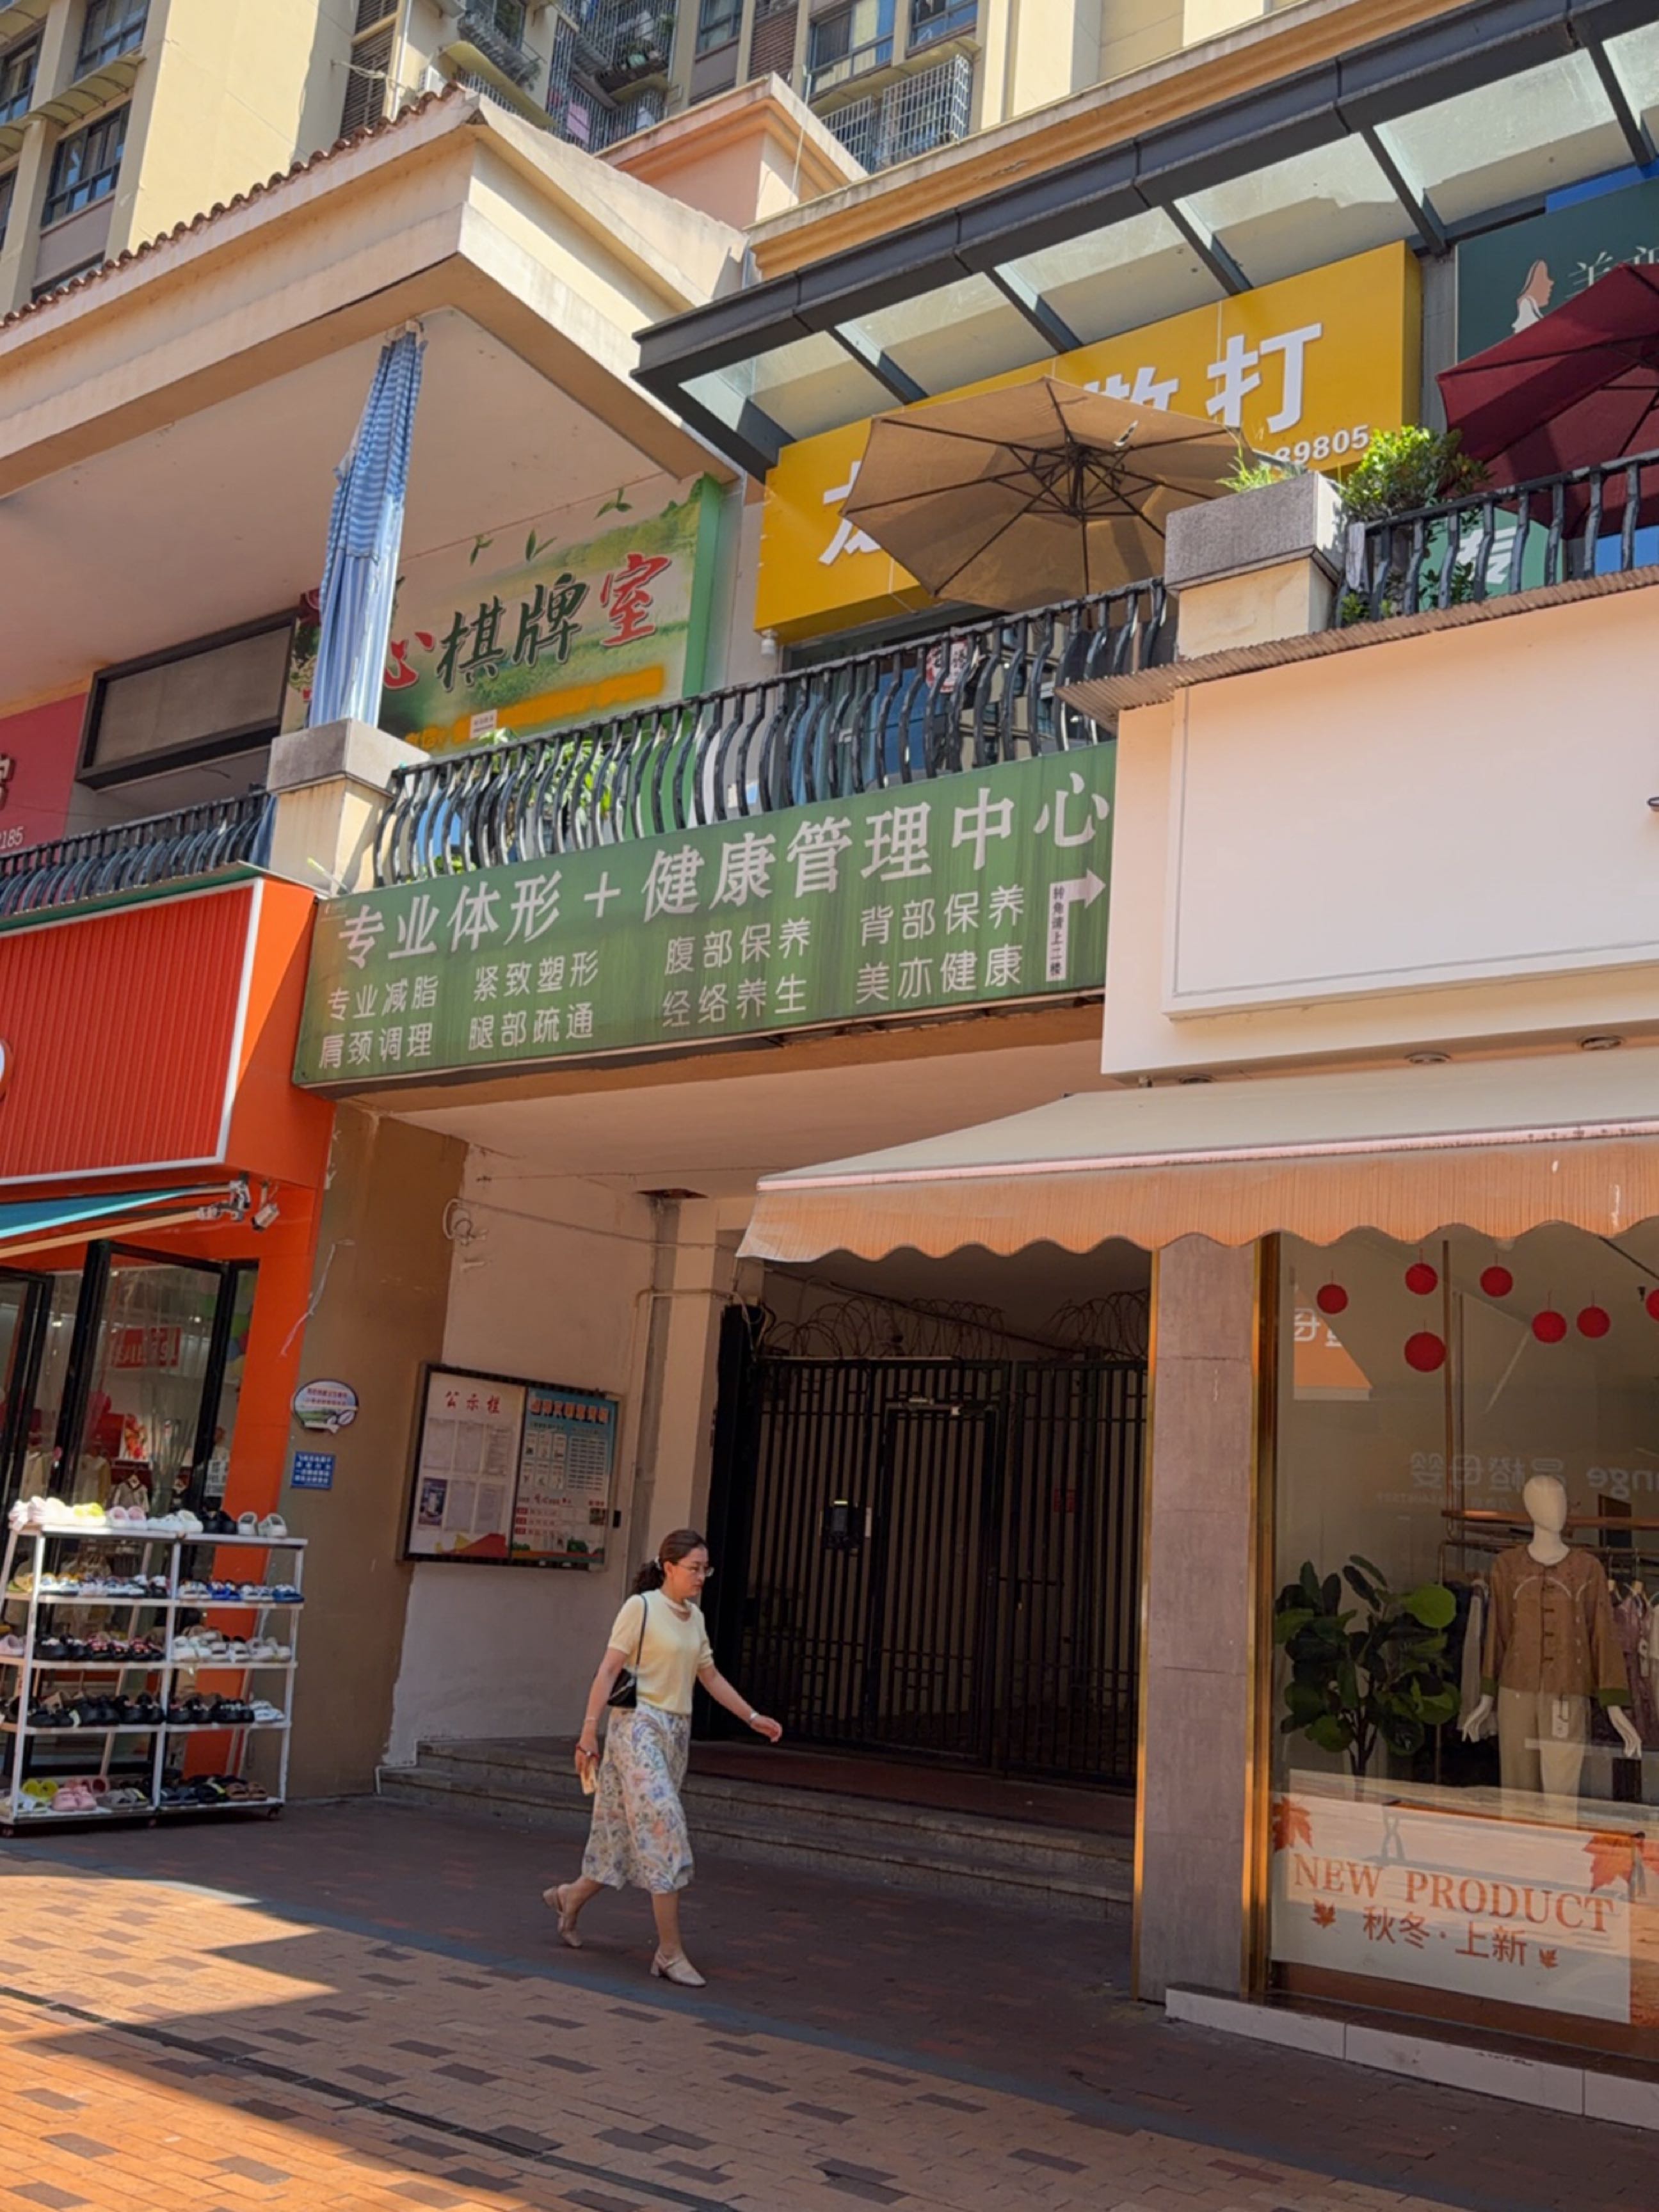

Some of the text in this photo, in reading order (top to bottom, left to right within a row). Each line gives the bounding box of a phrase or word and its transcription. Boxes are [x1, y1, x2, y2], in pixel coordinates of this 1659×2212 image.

[0, 826, 24, 849] 185
[326, 884, 1025, 1022] 专业减脂 紧致塑形 腹部保养 背部保养
[319, 944, 1024, 1070] 肩颈调理 腿部疏通 经络养生 美亦健康
[1294, 1853, 1614, 1933] NEW PRODUCT
[1363, 1905, 1527, 1966] 秋冬·上新
